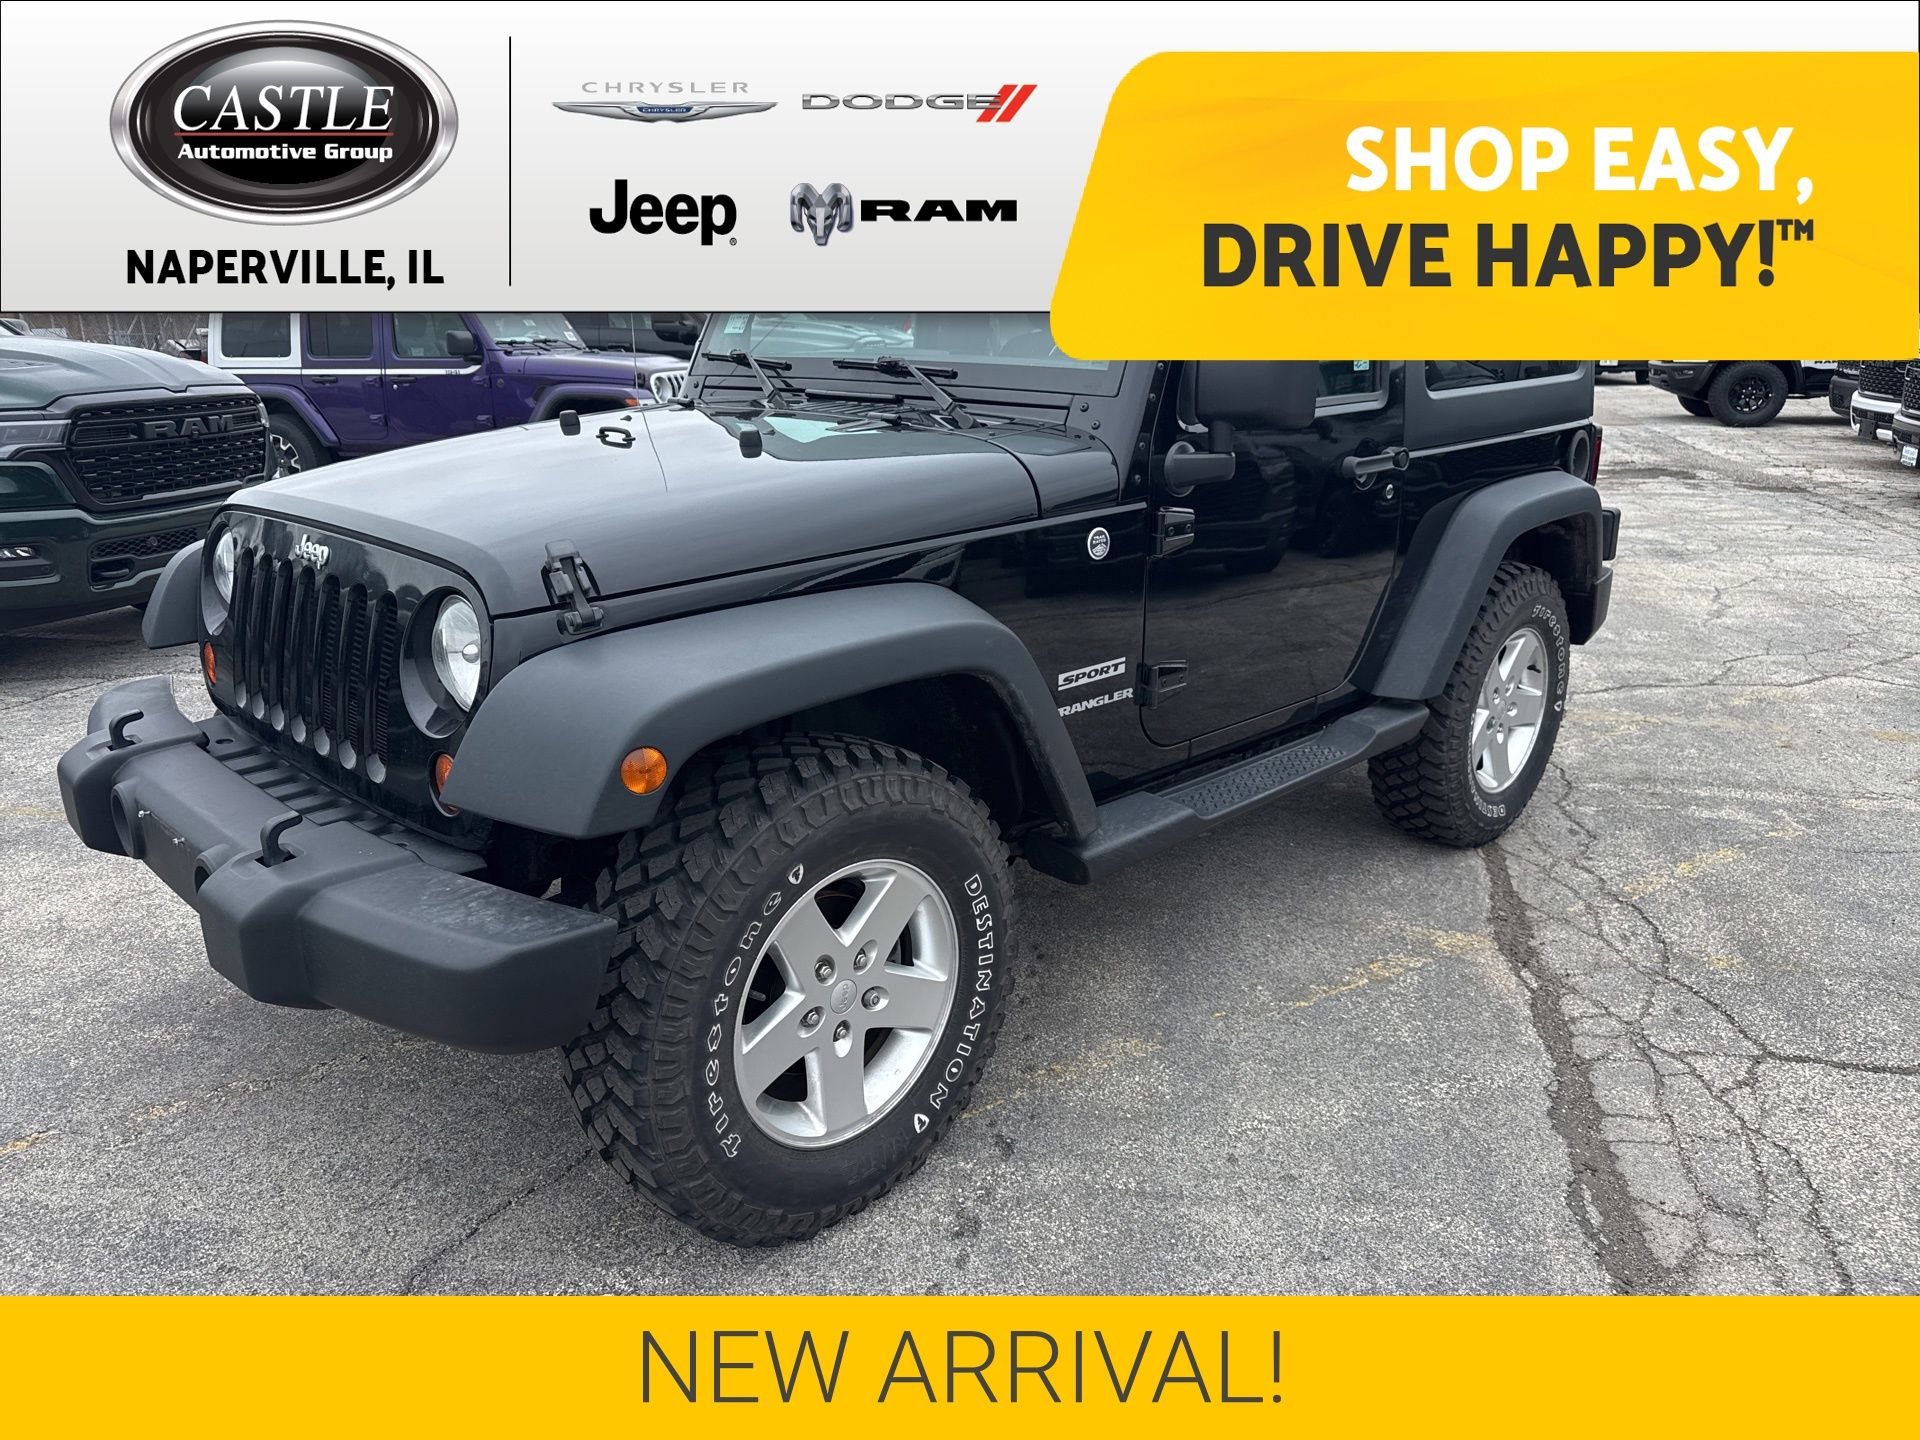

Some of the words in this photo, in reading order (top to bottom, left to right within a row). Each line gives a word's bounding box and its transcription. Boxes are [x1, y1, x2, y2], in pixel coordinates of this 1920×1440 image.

[142, 414, 234, 440] RAM
[294, 533, 330, 570] Jeep
[1059, 660, 1126, 687] SPORT
[1058, 687, 1134, 717] RANGLER
[929, 873, 994, 1111] DESTINATION
